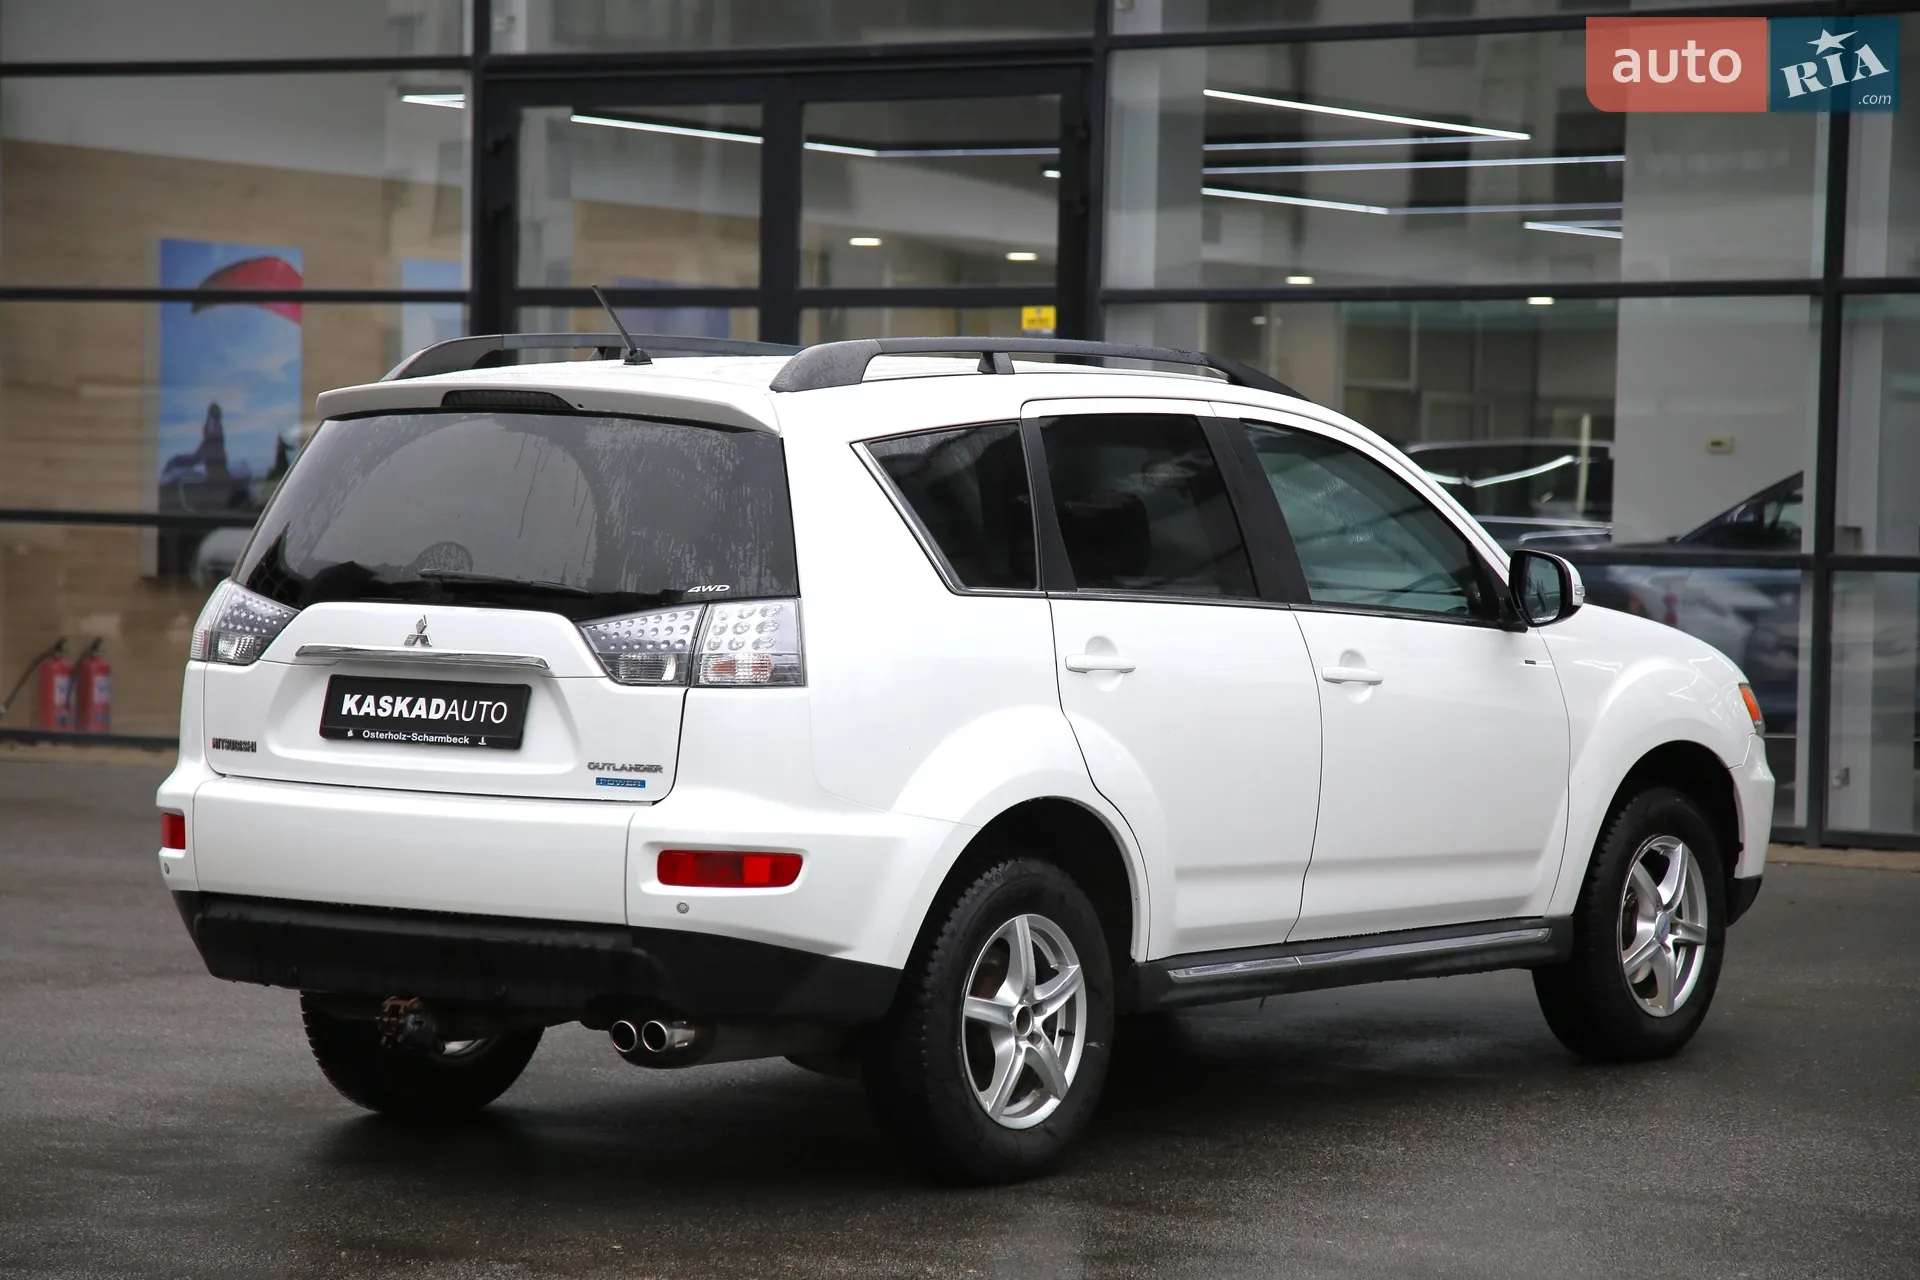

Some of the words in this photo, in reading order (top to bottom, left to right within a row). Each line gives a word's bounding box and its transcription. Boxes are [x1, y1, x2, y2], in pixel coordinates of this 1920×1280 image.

[687, 584, 730, 593] 4WD
[341, 693, 508, 724] KASKADAUTO
[362, 729, 470, 745] Osterholz-Scharmbeck
[211, 737, 257, 753] MITSUBISHI
[587, 761, 663, 773] OUTLANDER
[600, 778, 642, 787] POWER
